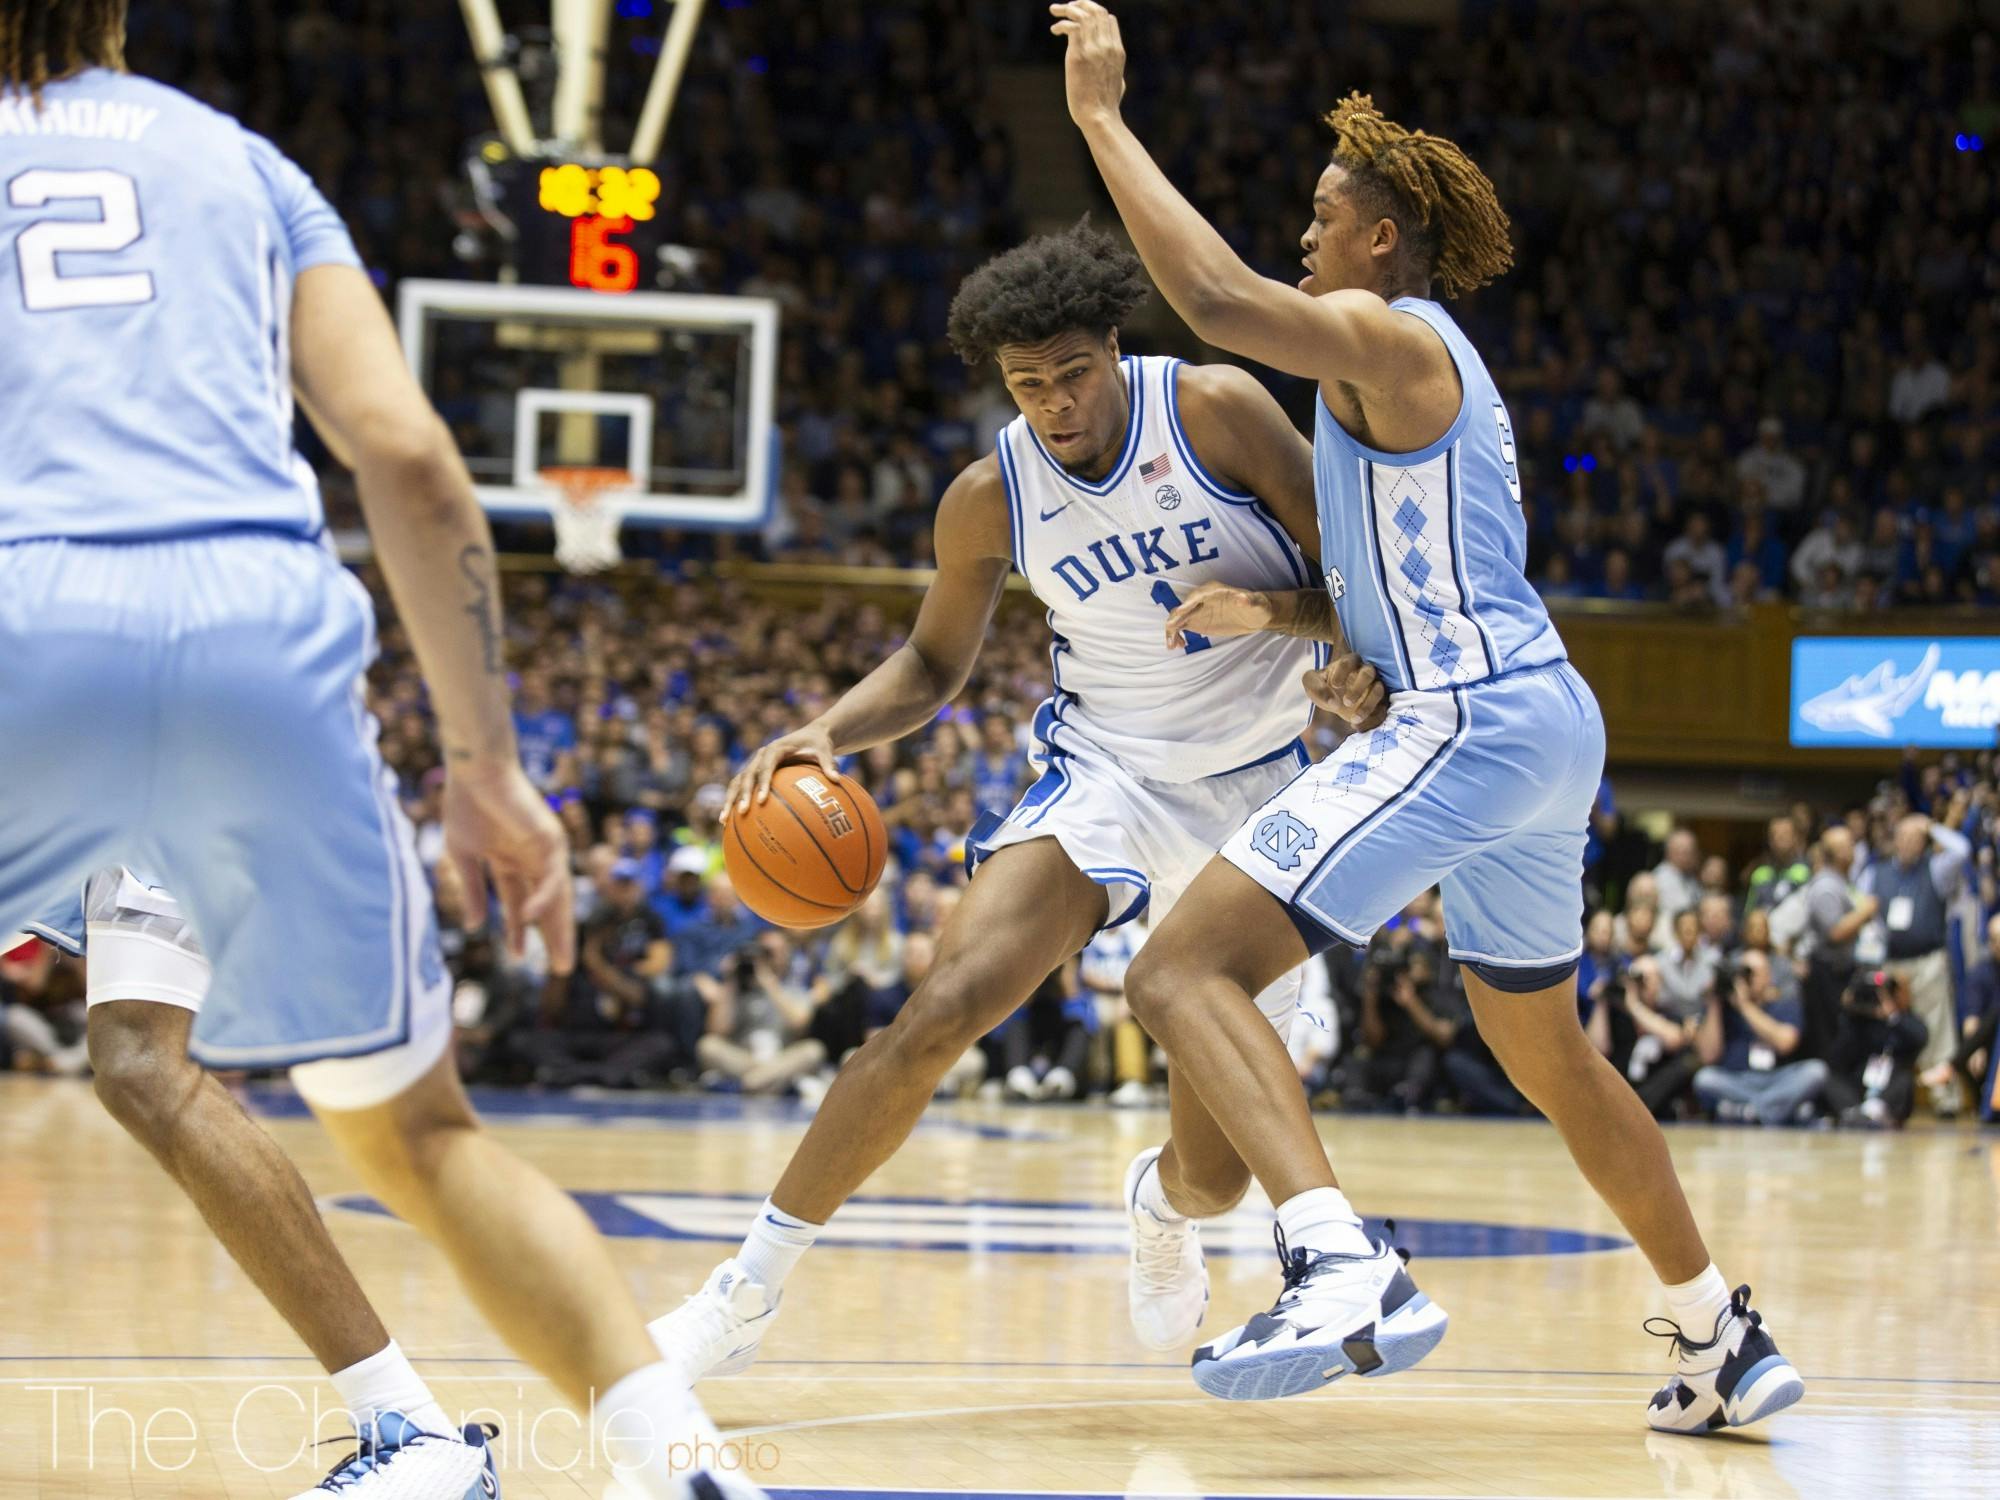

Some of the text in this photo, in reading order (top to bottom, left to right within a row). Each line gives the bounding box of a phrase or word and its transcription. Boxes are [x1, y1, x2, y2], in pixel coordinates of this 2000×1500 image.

[7, 166, 157, 313] 2
[570, 216, 639, 296] 16
[1051, 517, 1219, 602] DUKE
[1150, 579, 1213, 655] 1
[794, 775, 854, 840] ELITE
